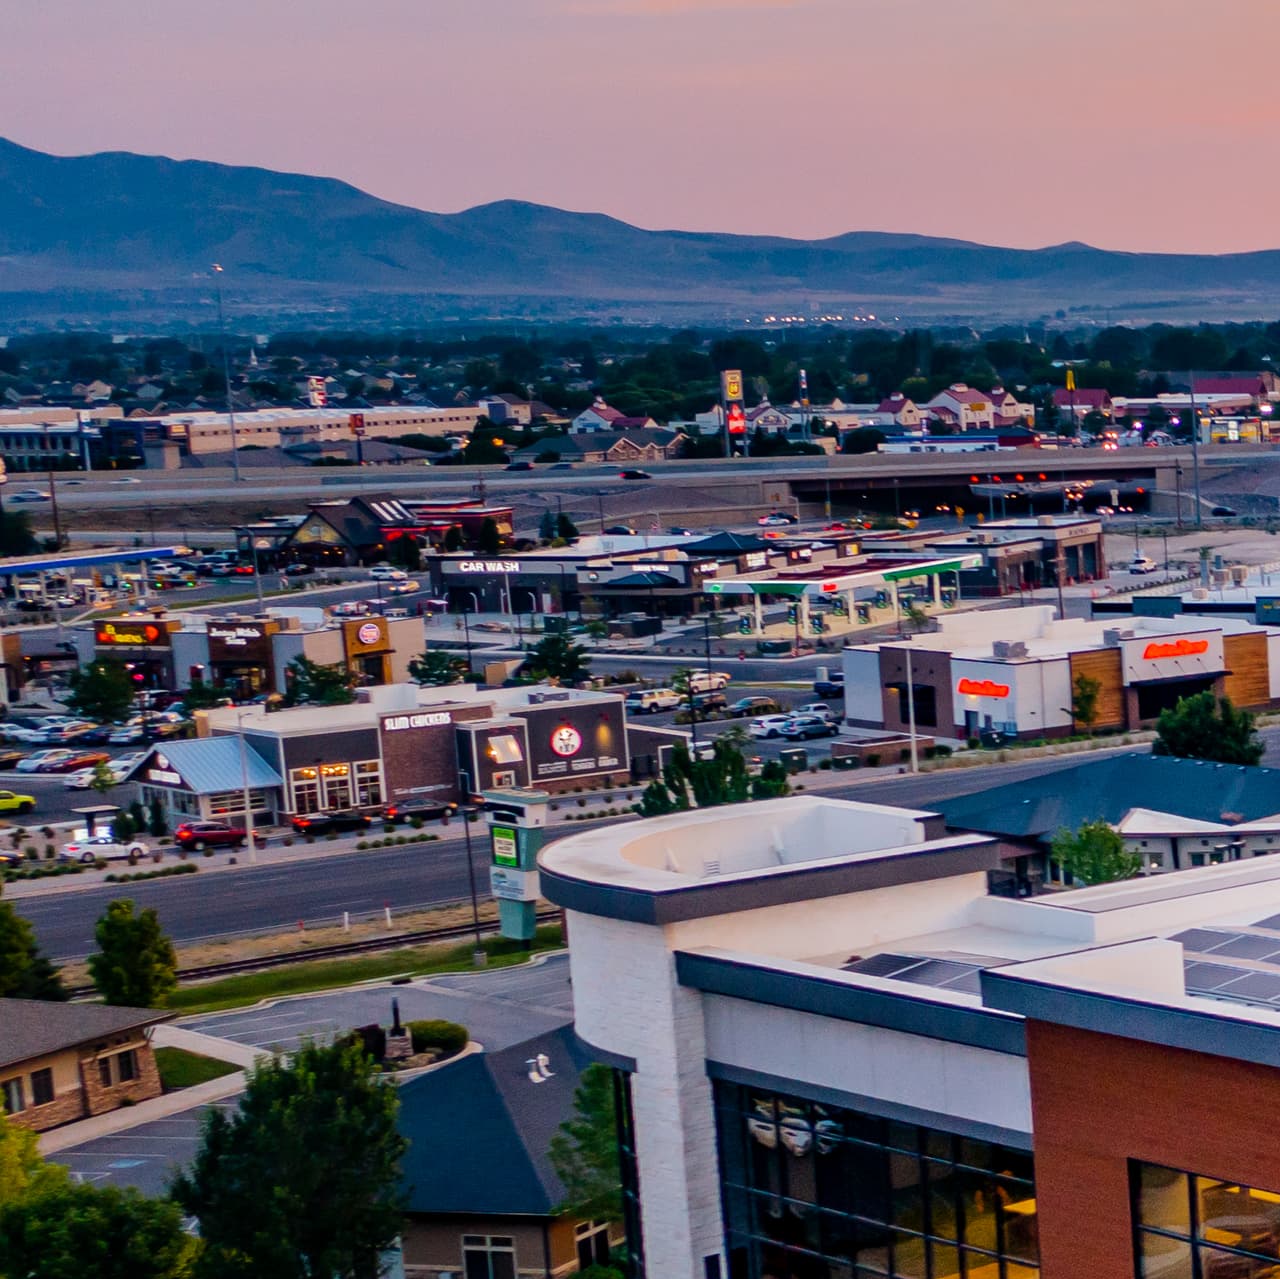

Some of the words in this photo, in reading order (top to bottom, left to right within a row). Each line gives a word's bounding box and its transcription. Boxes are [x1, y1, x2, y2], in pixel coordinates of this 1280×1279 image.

[460, 561, 484, 573] CAR
[485, 561, 520, 573] WASH
[385, 717, 410, 730] SLIM
[410, 712, 451, 727] CHICKENS
